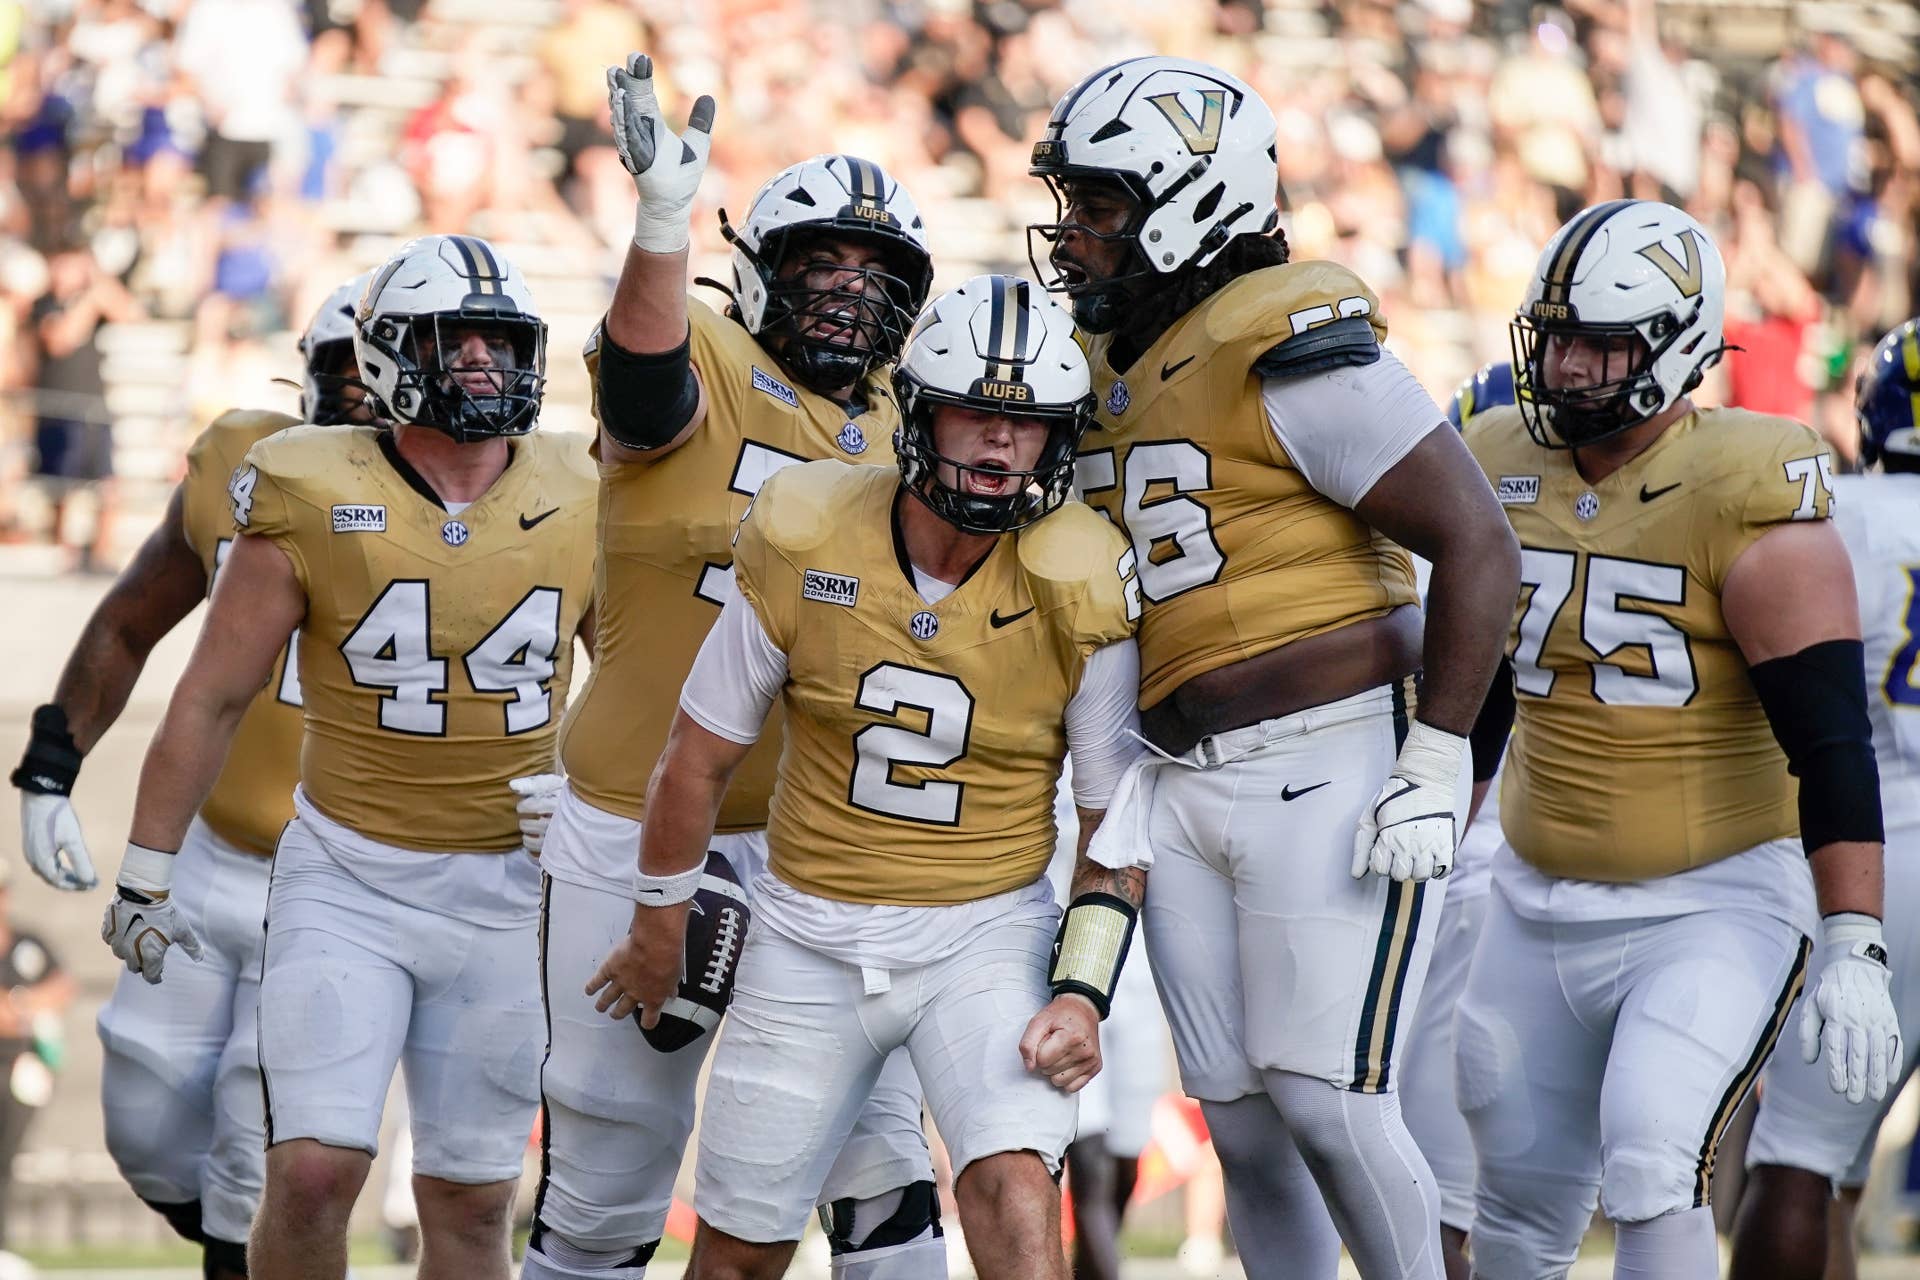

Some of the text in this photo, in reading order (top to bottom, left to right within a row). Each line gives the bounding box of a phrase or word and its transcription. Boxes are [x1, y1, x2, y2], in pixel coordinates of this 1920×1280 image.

[1144, 89, 1227, 155] V
[854, 205, 889, 222] VUFB
[1635, 228, 1703, 299] V
[1534, 302, 1568, 319] VUFB
[761, 374, 794, 400] SRM
[982, 382, 1027, 400] VUFB
[842, 423, 862, 447] SEC
[228, 464, 258, 527] 4
[1507, 480, 1537, 493] SRM
[343, 508, 384, 522] SRM
[443, 522, 468, 545] SEC
[805, 589, 854, 603] CONCRETE
[815, 577, 857, 597] SRM
[911, 612, 938, 639] SEC
[1511, 548, 1700, 707] 75
[338, 579, 562, 737] 44
[848, 660, 976, 827] 2
